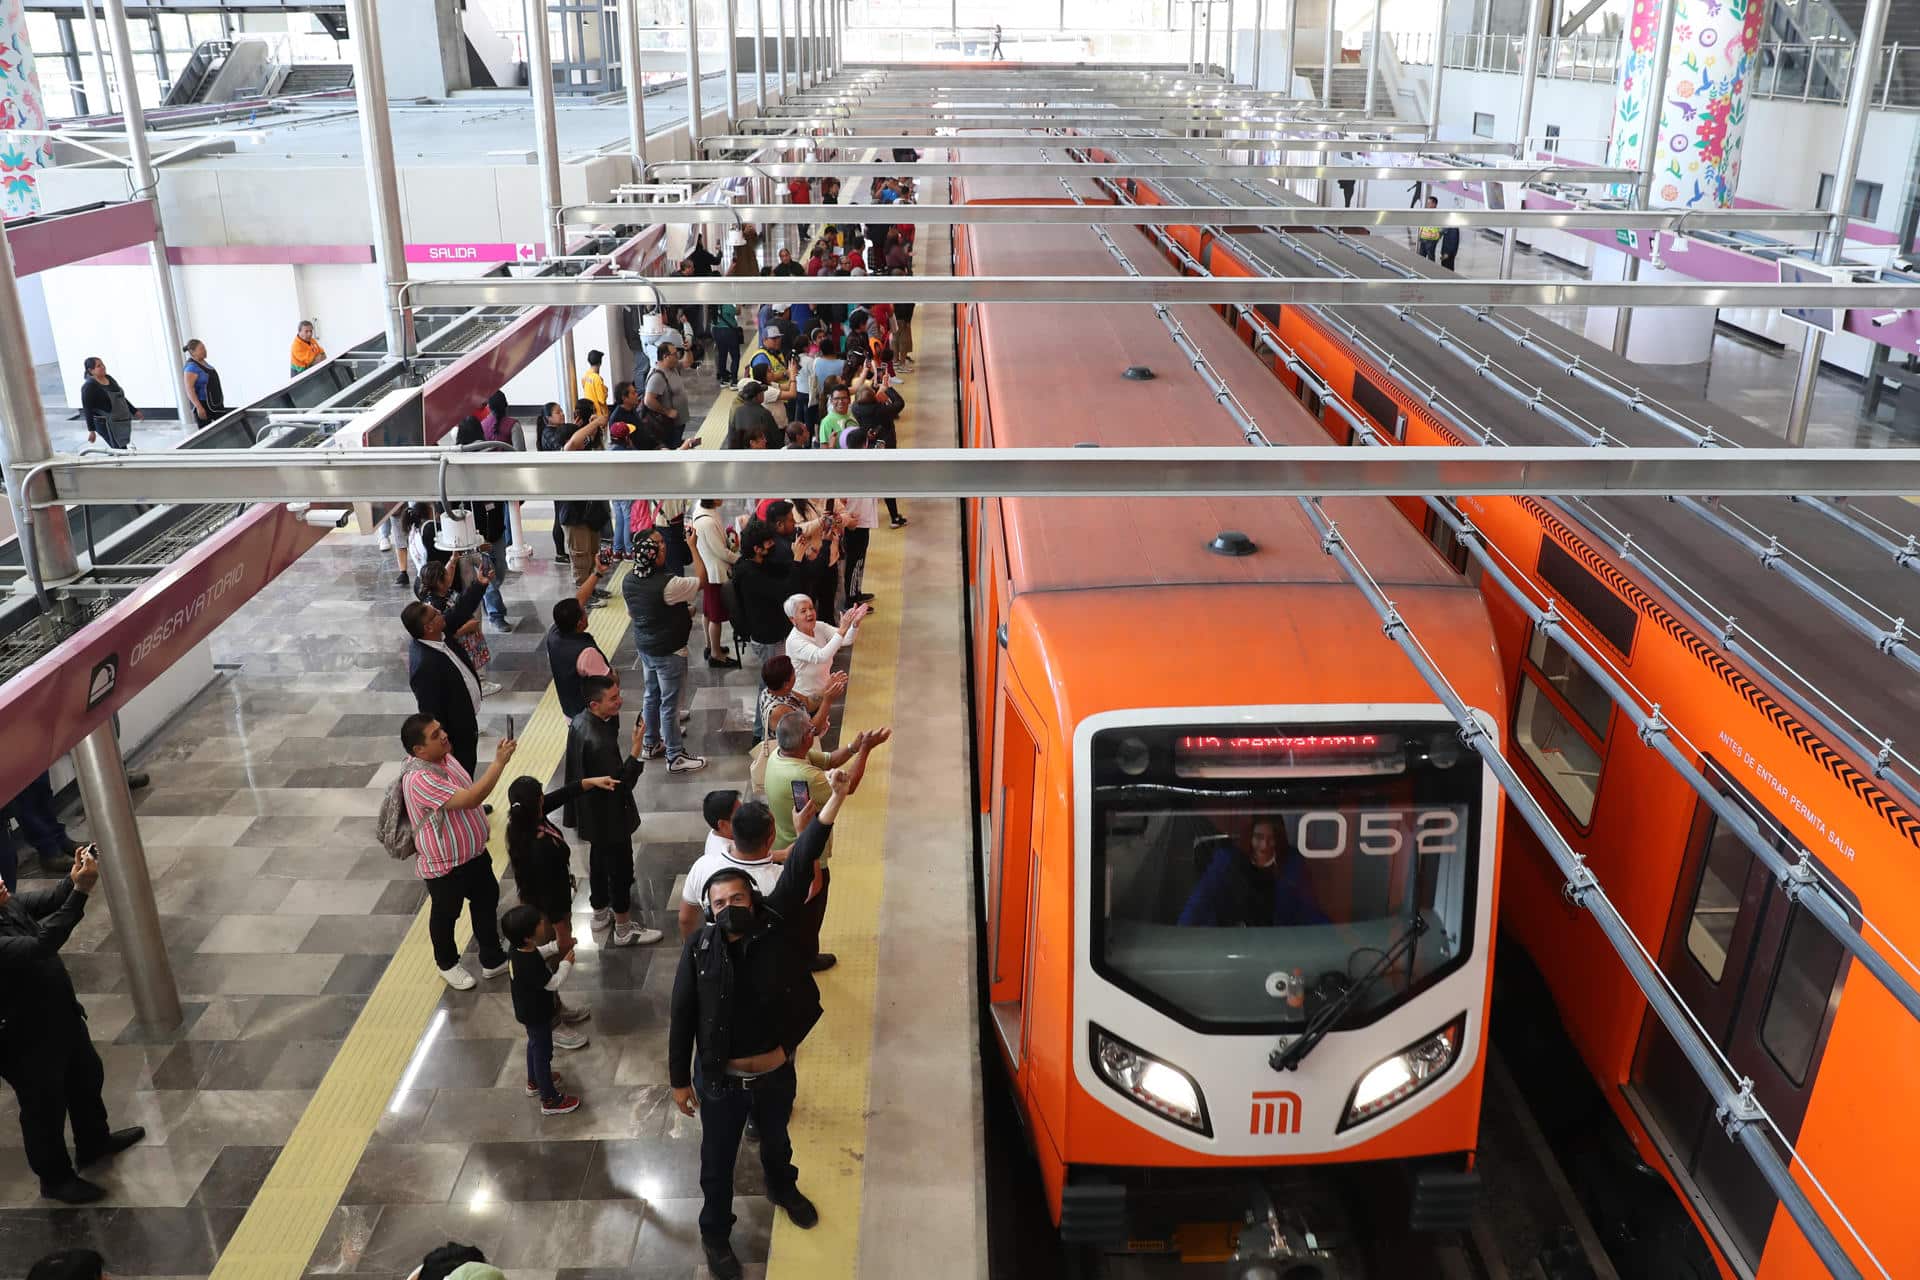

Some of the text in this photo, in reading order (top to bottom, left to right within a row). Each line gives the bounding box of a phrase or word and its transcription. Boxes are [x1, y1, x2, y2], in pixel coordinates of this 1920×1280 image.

[429, 247, 477, 259] SALIDA
[130, 563, 244, 667] OBSERVATORIO
[1719, 731, 1856, 861] ANTES DE ENTRAR PERMITA SALIR
[1297, 810, 1459, 859] 052
